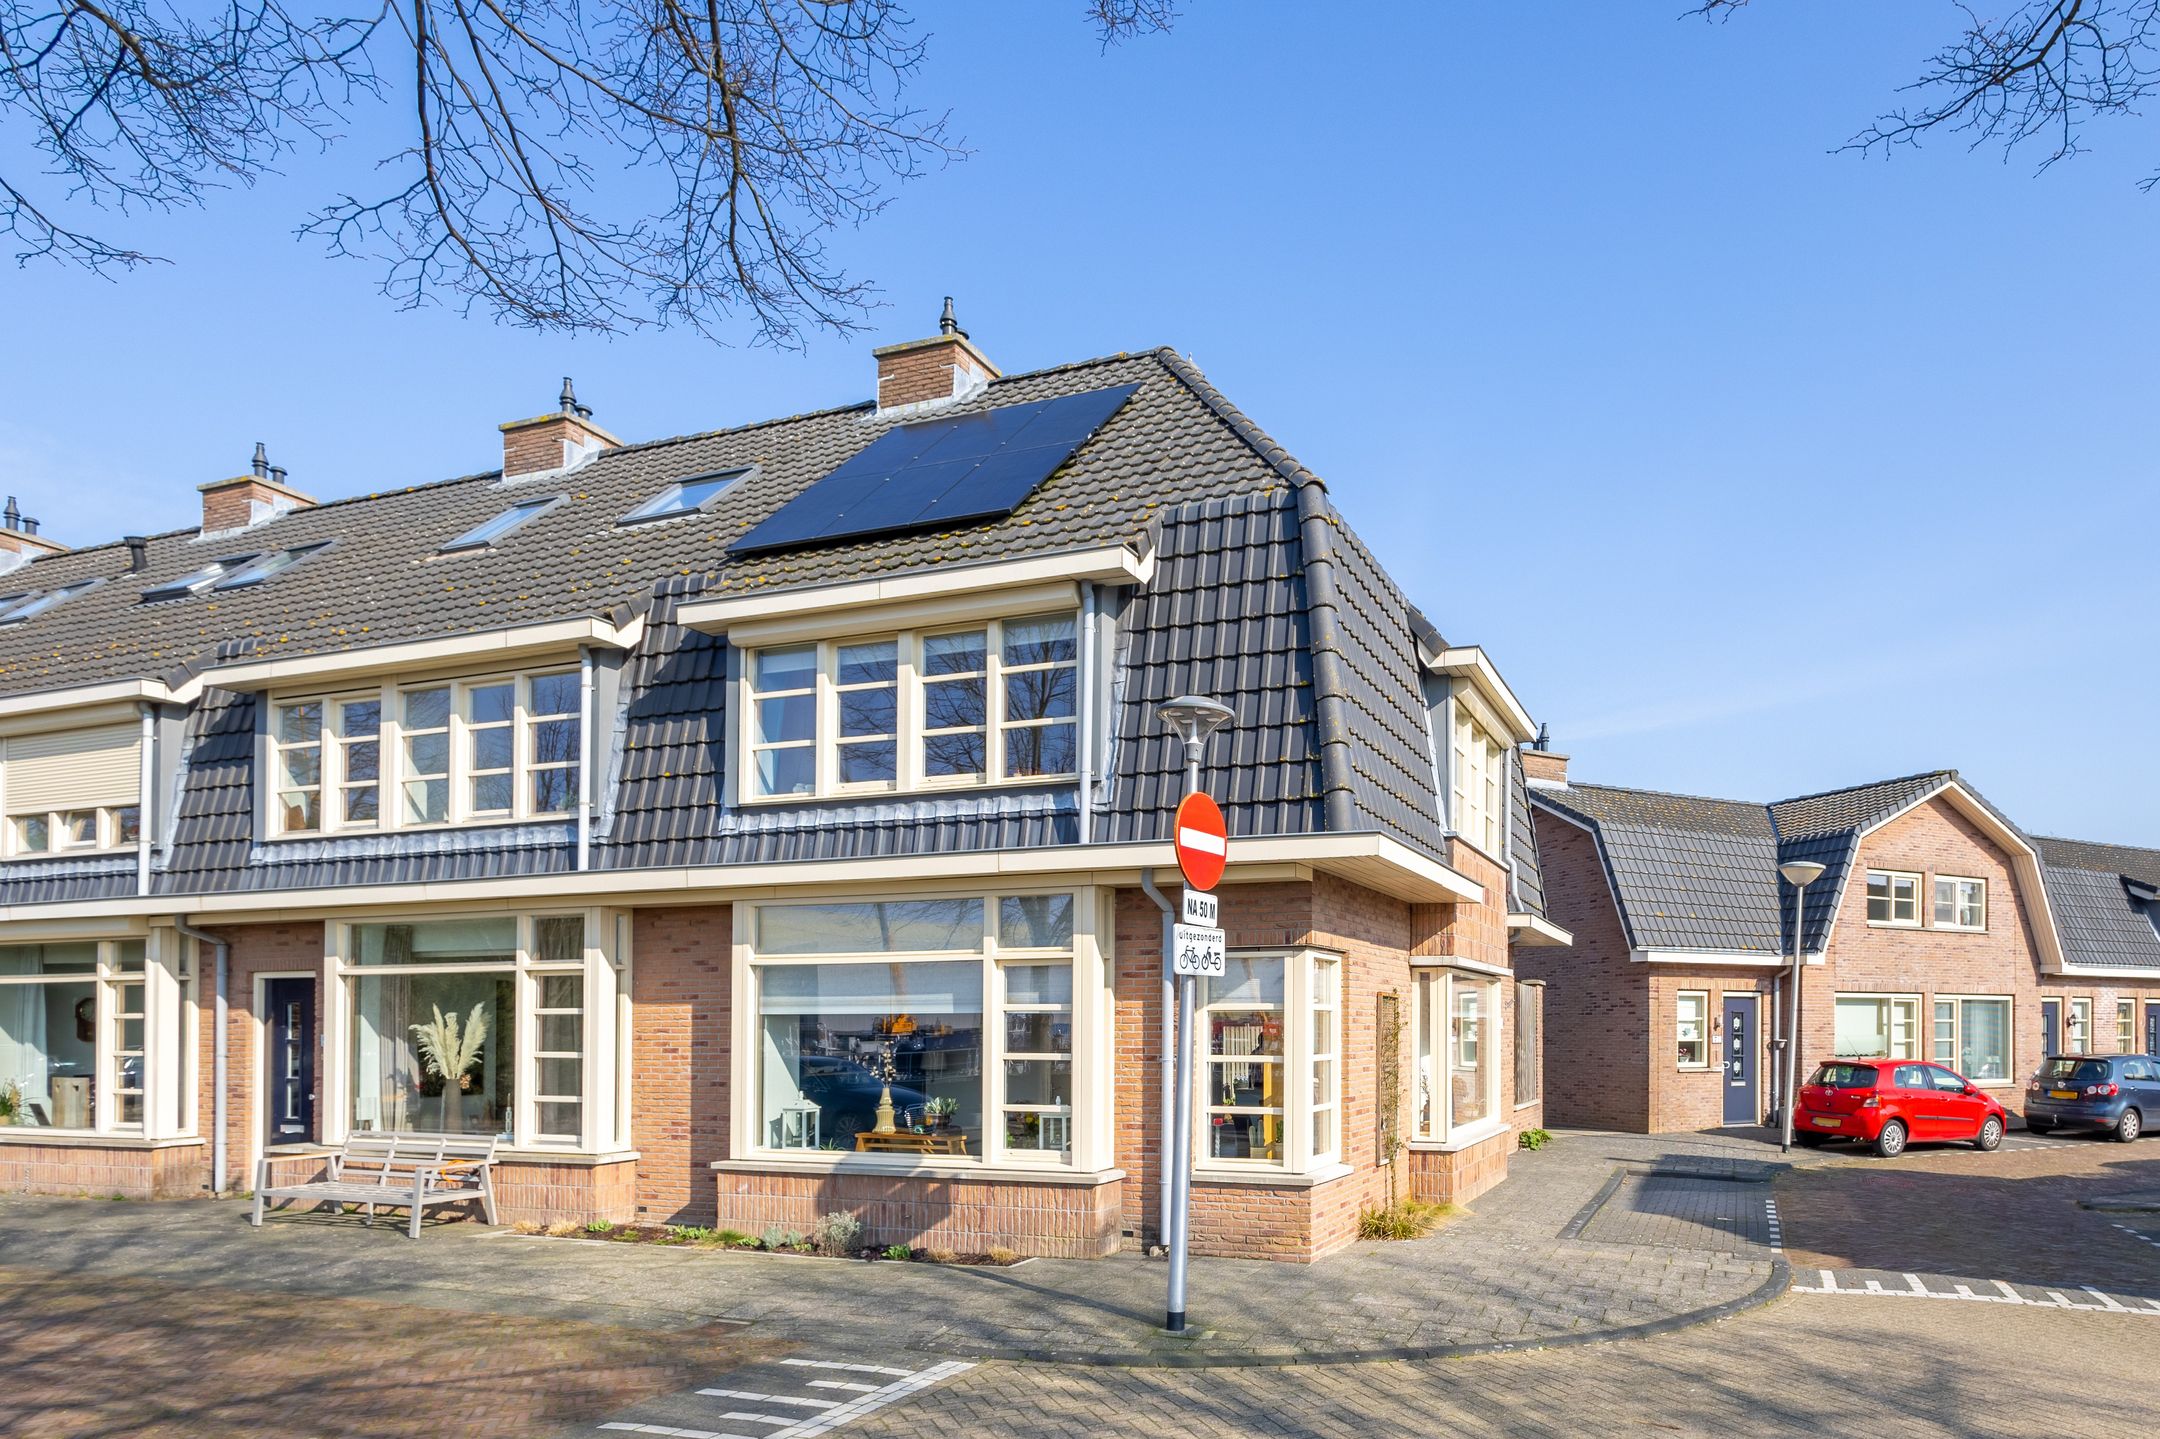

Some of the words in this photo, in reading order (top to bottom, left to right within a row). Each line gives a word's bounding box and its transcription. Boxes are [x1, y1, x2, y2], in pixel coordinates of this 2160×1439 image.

[1187, 898, 1198, 916] NA
[1199, 901, 1208, 918] 50
[1209, 903, 1216, 920] M
[1178, 930, 1222, 943] uitgezonderd
